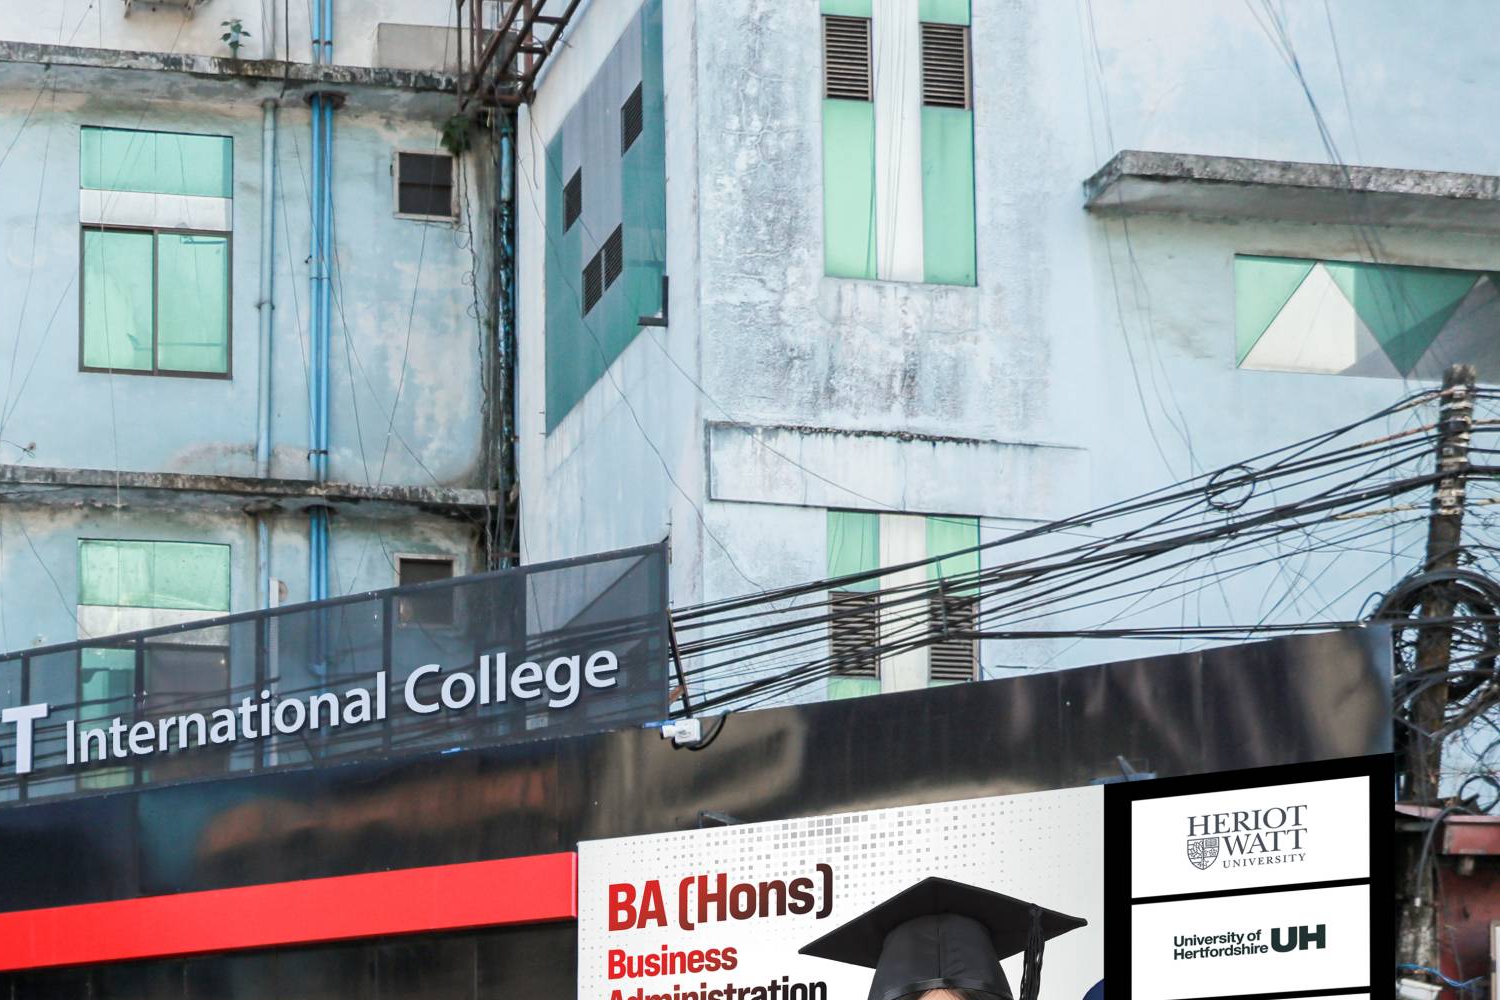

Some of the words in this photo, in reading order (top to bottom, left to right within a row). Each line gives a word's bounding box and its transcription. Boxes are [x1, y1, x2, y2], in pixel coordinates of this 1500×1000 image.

[65, 670, 387, 766] International
[404, 649, 619, 714] College
[1187, 804, 1308, 837] HERIOT
[1222, 827, 1308, 856] WATT
[1222, 852, 1307, 869] UNIVERSITY
[608, 879, 668, 932] BA
[678, 863, 834, 931] (Hons)
[1173, 931, 1245, 948] University
[1247, 929, 1262, 942] of
[1173, 942, 1269, 961] Hertfordshire
[1271, 923, 1326, 953] UH
[607, 944, 739, 980] Business
